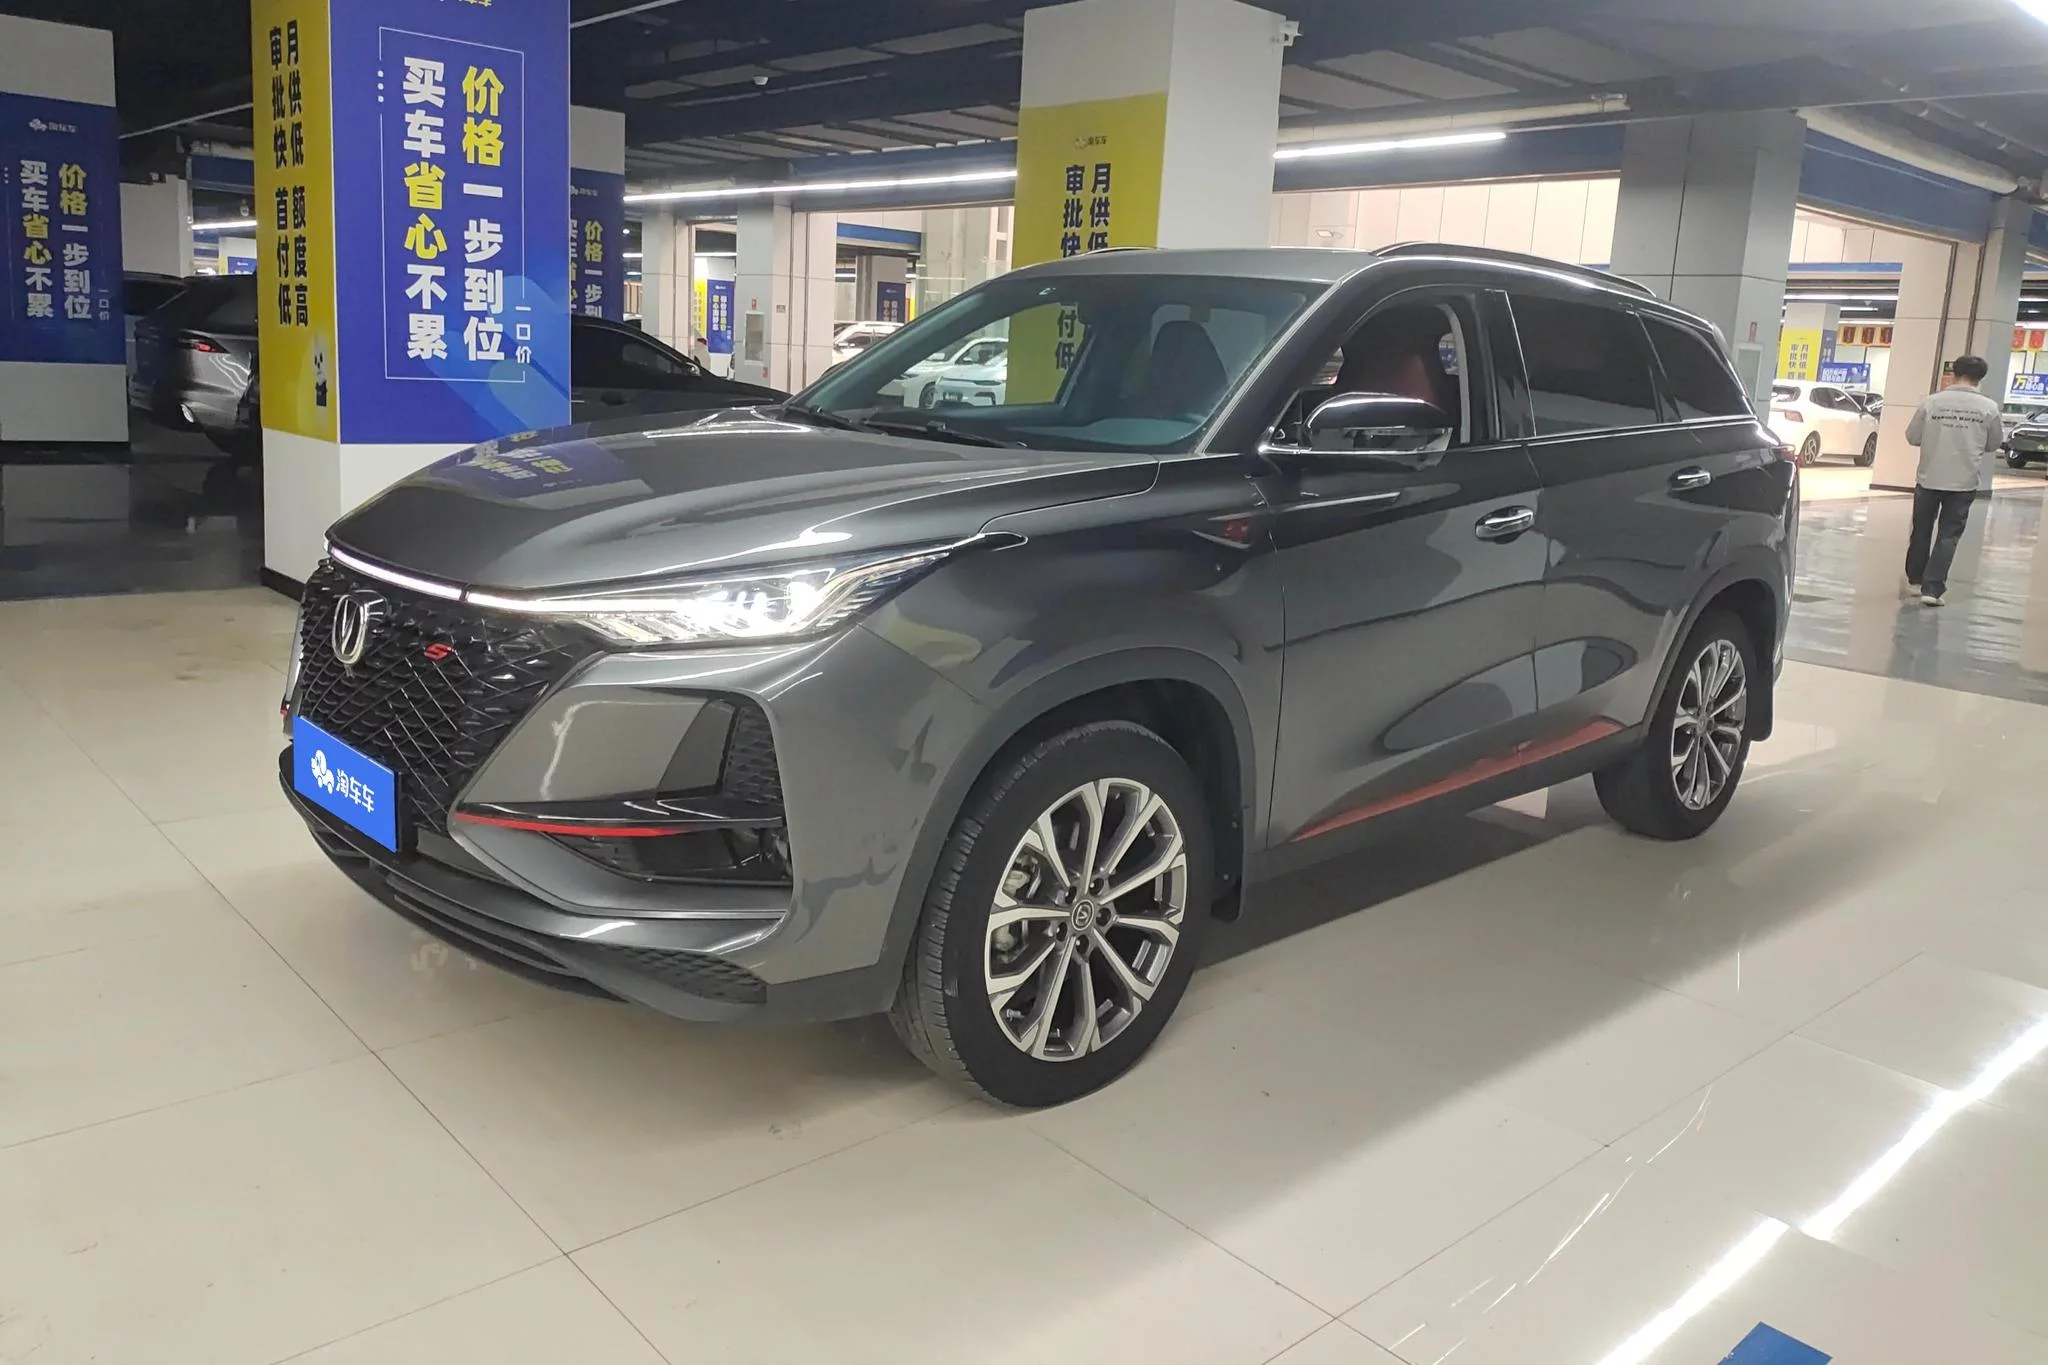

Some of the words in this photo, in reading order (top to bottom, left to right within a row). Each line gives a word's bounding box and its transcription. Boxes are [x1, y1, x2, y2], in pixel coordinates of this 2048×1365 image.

[269, 26, 287, 169] 审批快
[287, 19, 304, 166] 月供低
[20, 160, 54, 318] 买车省心不累
[59, 162, 92, 320] 价格一步到位
[275, 187, 292, 327] 首付低
[292, 185, 308, 327] 额度高
[403, 56, 447, 360] 买车省心不累
[462, 65, 505, 361] 价格一步到位
[1061, 164, 1085, 258] 审批快
[1088, 163, 1111, 252] 月供低
[515, 305, 532, 364] 一口价
[335, 768, 375, 813] 淘车车
